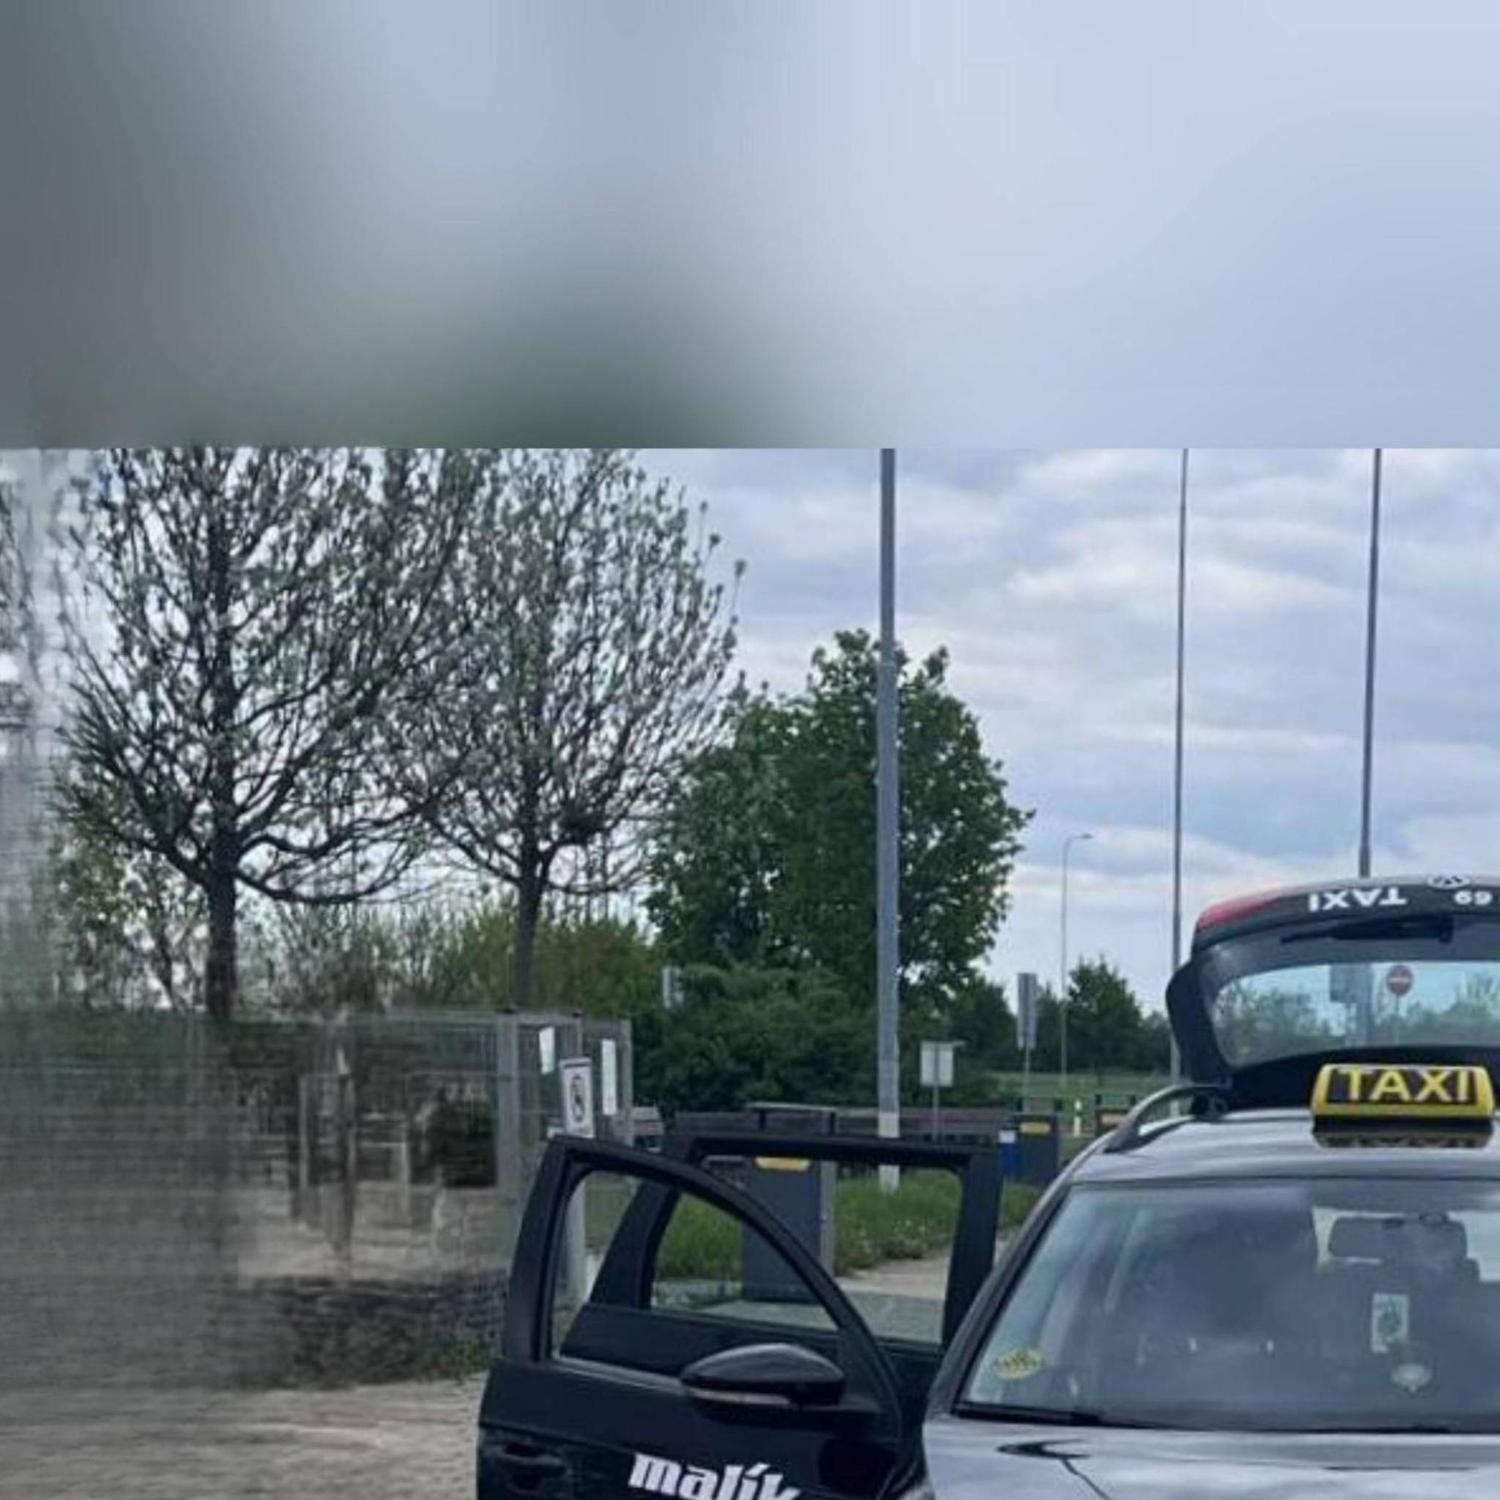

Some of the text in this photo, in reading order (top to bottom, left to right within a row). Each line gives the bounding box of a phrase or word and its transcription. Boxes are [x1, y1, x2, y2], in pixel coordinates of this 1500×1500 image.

[1309, 887, 1408, 912] TAXI
[1454, 890, 1493, 906] 69
[1337, 1065, 1470, 1103] TAXI
